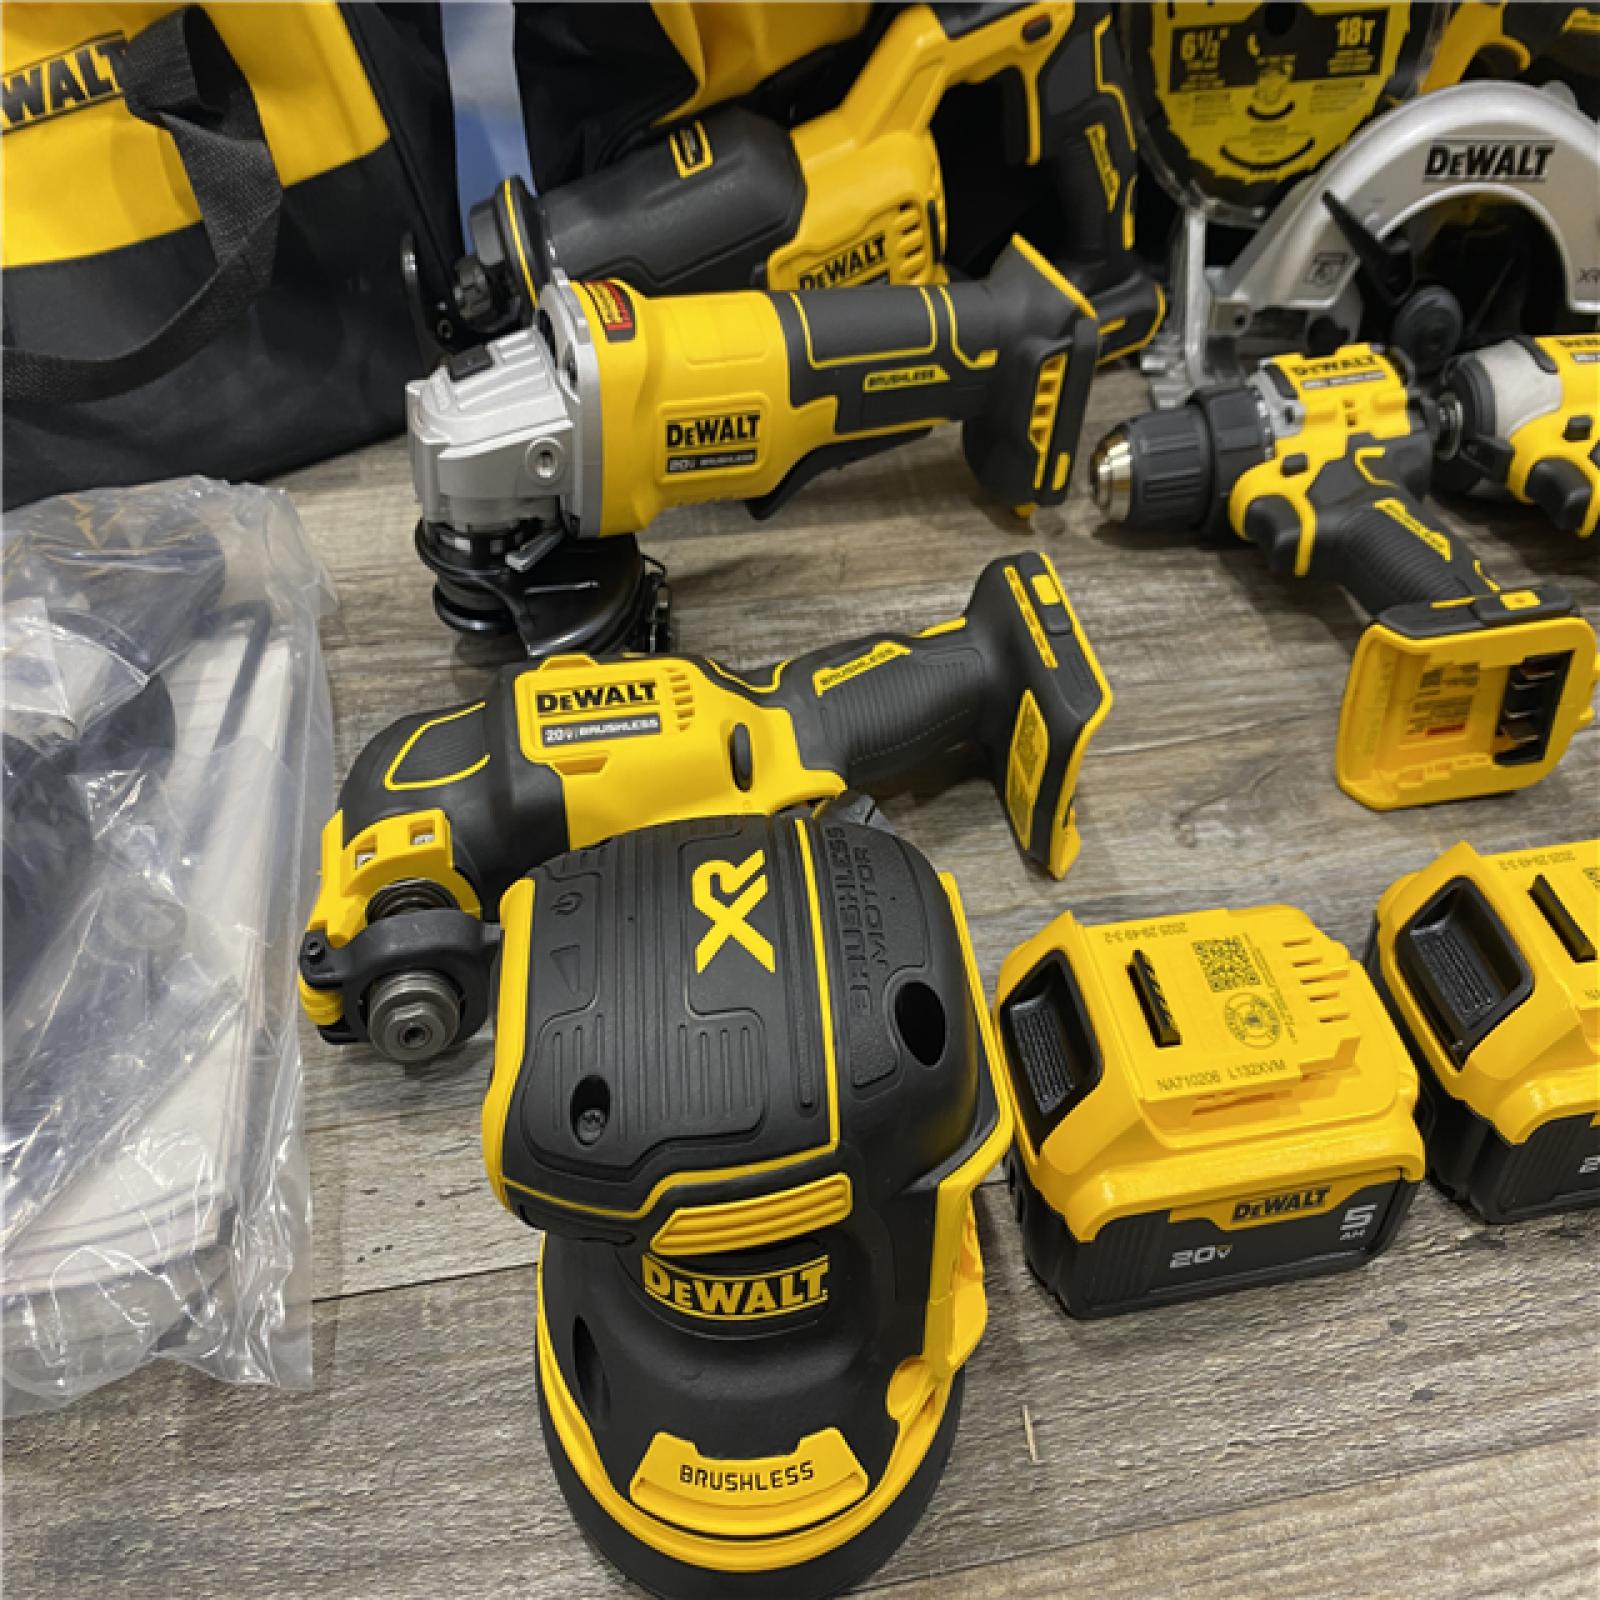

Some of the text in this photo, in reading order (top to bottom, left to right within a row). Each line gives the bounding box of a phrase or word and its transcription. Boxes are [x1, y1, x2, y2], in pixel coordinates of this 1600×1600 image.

[1335, 16, 1376, 46] 18T
[1424, 144, 1556, 177] DEWALT
[666, 414, 760, 447] DEWALT
[537, 683, 656, 713] DEWALT
[691, 849, 776, 974] XR
[853, 846, 890, 971] MOTOR
[1233, 1186, 1331, 1222] DEWALT
[1340, 1204, 1378, 1230] 5
[642, 1255, 829, 1317] DEWALT
[679, 1459, 815, 1492] BRUSHLESS
